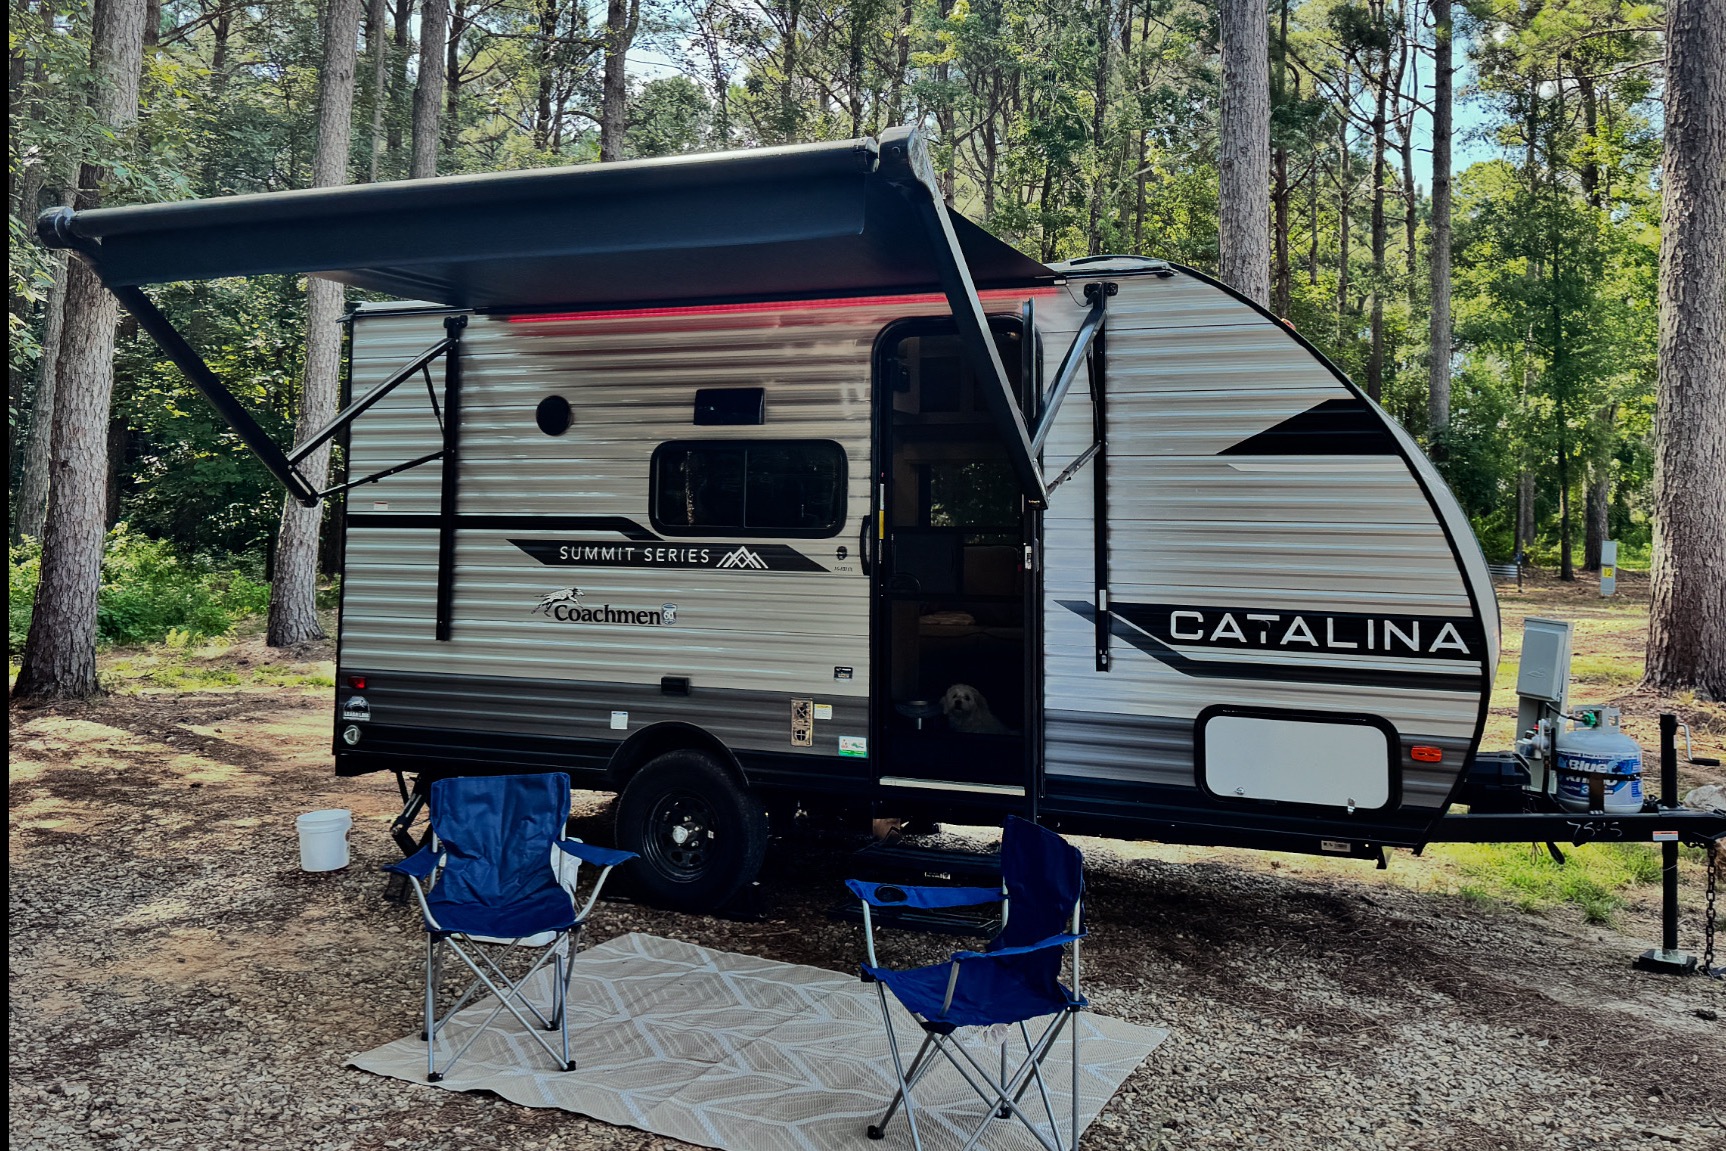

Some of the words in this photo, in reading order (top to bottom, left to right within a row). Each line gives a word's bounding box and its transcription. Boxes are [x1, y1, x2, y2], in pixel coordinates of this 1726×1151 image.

[559, 545, 635, 561] SUMMIT
[644, 547, 710, 563] SERIES
[554, 604, 661, 625] Coachmen
[1170, 610, 1471, 654] CATALINA
[1568, 759, 1607, 773] Blue
